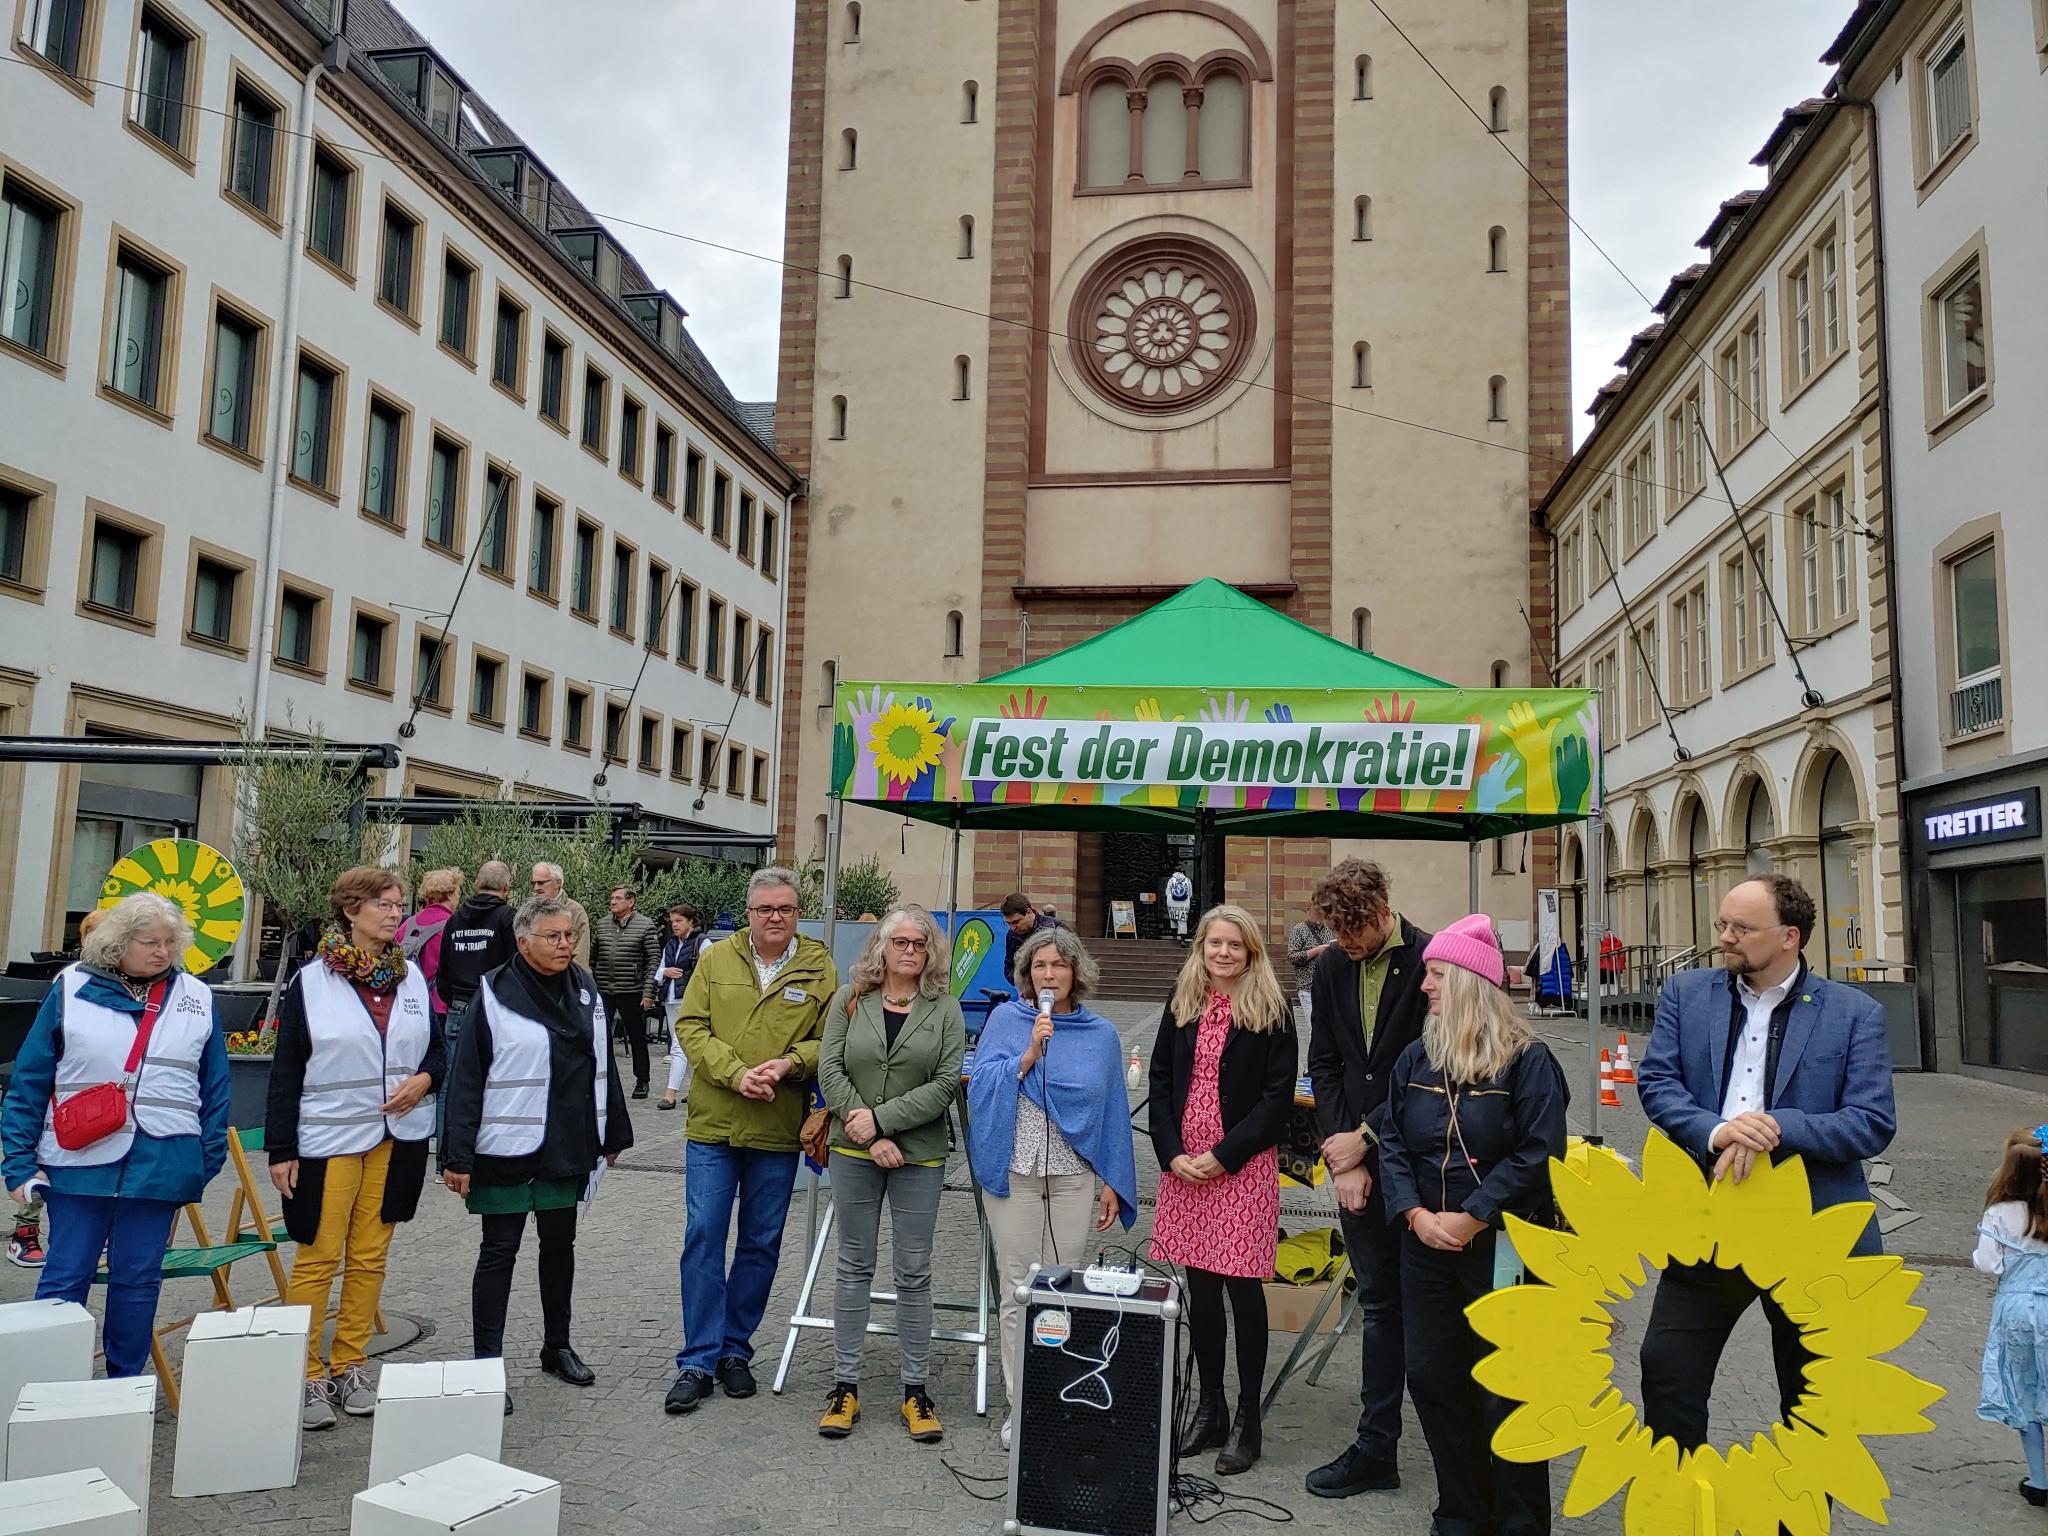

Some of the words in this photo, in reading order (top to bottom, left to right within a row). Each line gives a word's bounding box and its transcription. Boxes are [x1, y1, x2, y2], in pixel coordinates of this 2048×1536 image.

[968, 721, 1070, 780] Fest
[1077, 724, 1160, 781] der
[1166, 725, 1472, 786] Demokratie!
[1924, 800, 2026, 841] TRETTER
[176, 1006, 206, 1017] RECHTS
